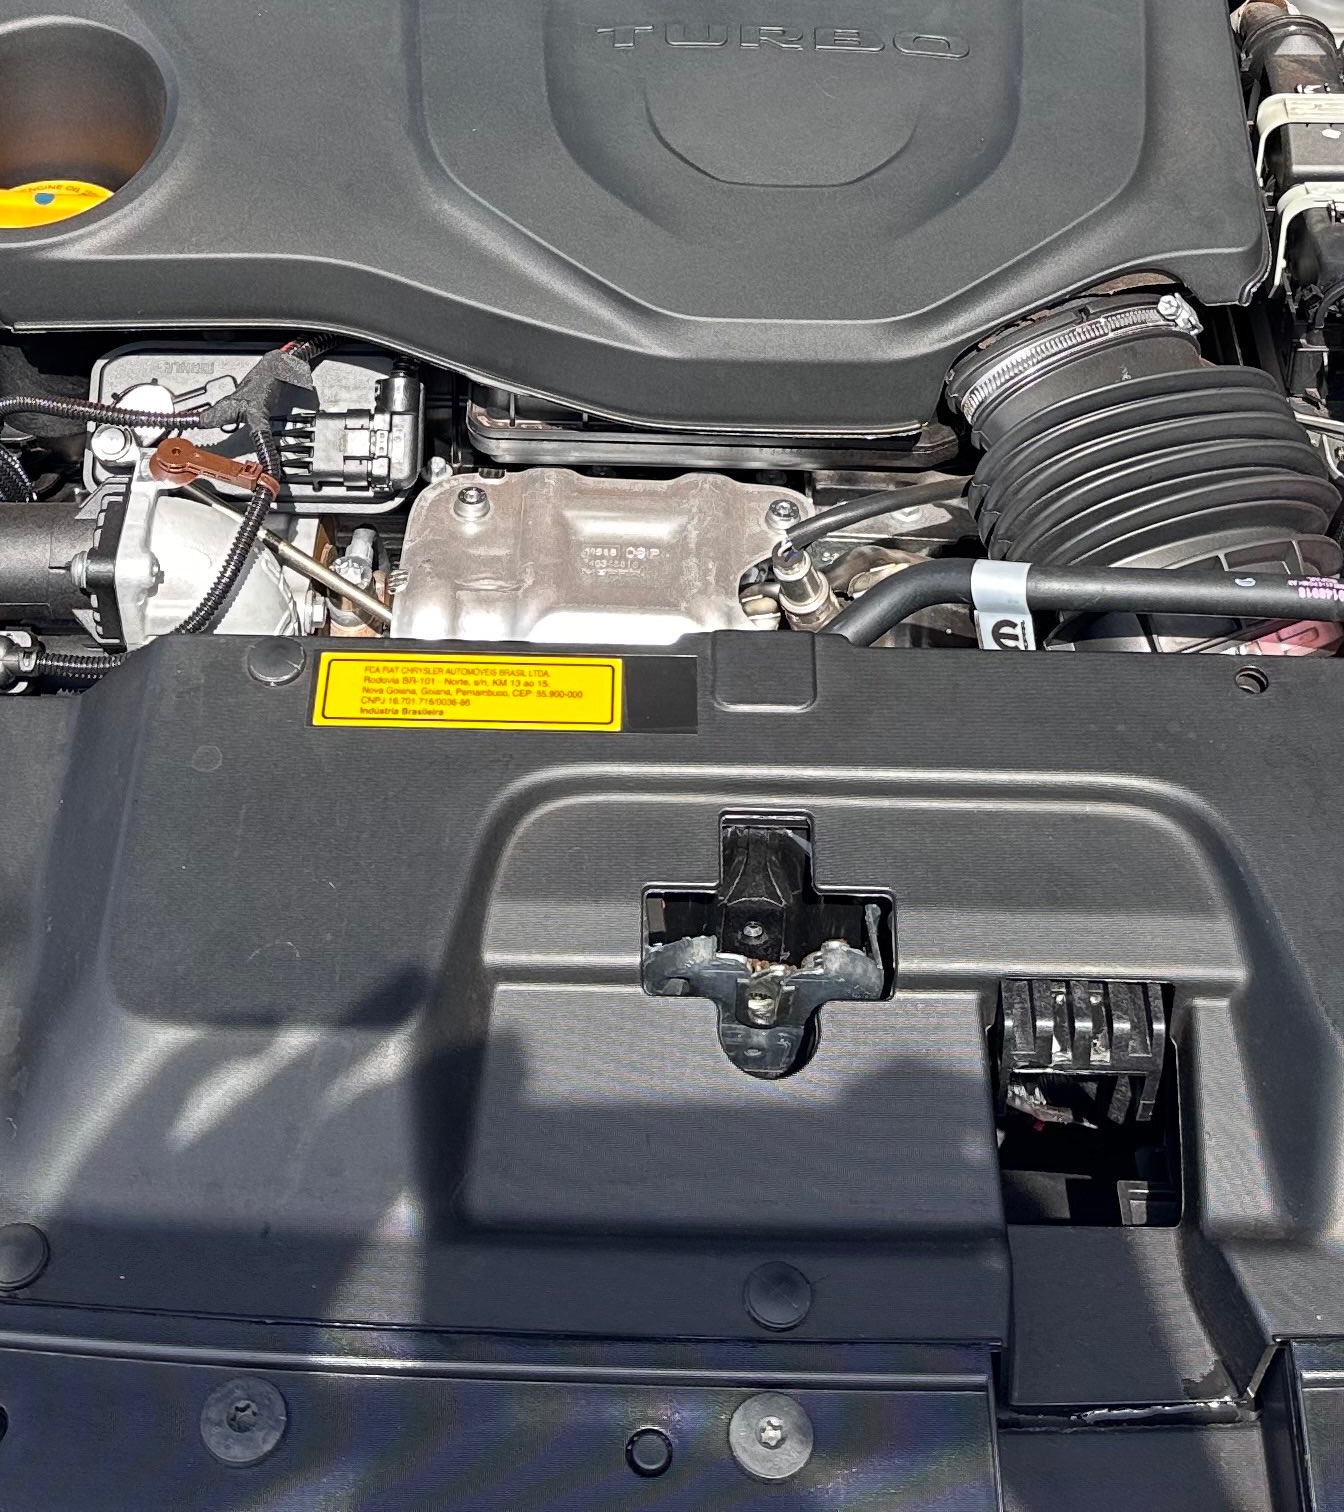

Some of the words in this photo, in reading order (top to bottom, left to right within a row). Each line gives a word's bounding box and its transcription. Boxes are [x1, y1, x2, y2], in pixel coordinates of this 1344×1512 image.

[597, 23, 970, 58] TURBO
[364, 666, 380, 674] FCA
[382, 666, 399, 674] FIAT
[401, 667, 443, 675] CHRYSLER
[499, 669, 526, 677] BRASIL
[363, 676, 400, 685] Rodovia
[362, 686, 384, 694] Nova
[361, 696, 386, 705] CNPJ
[401, 707, 444, 716] Brasileira
